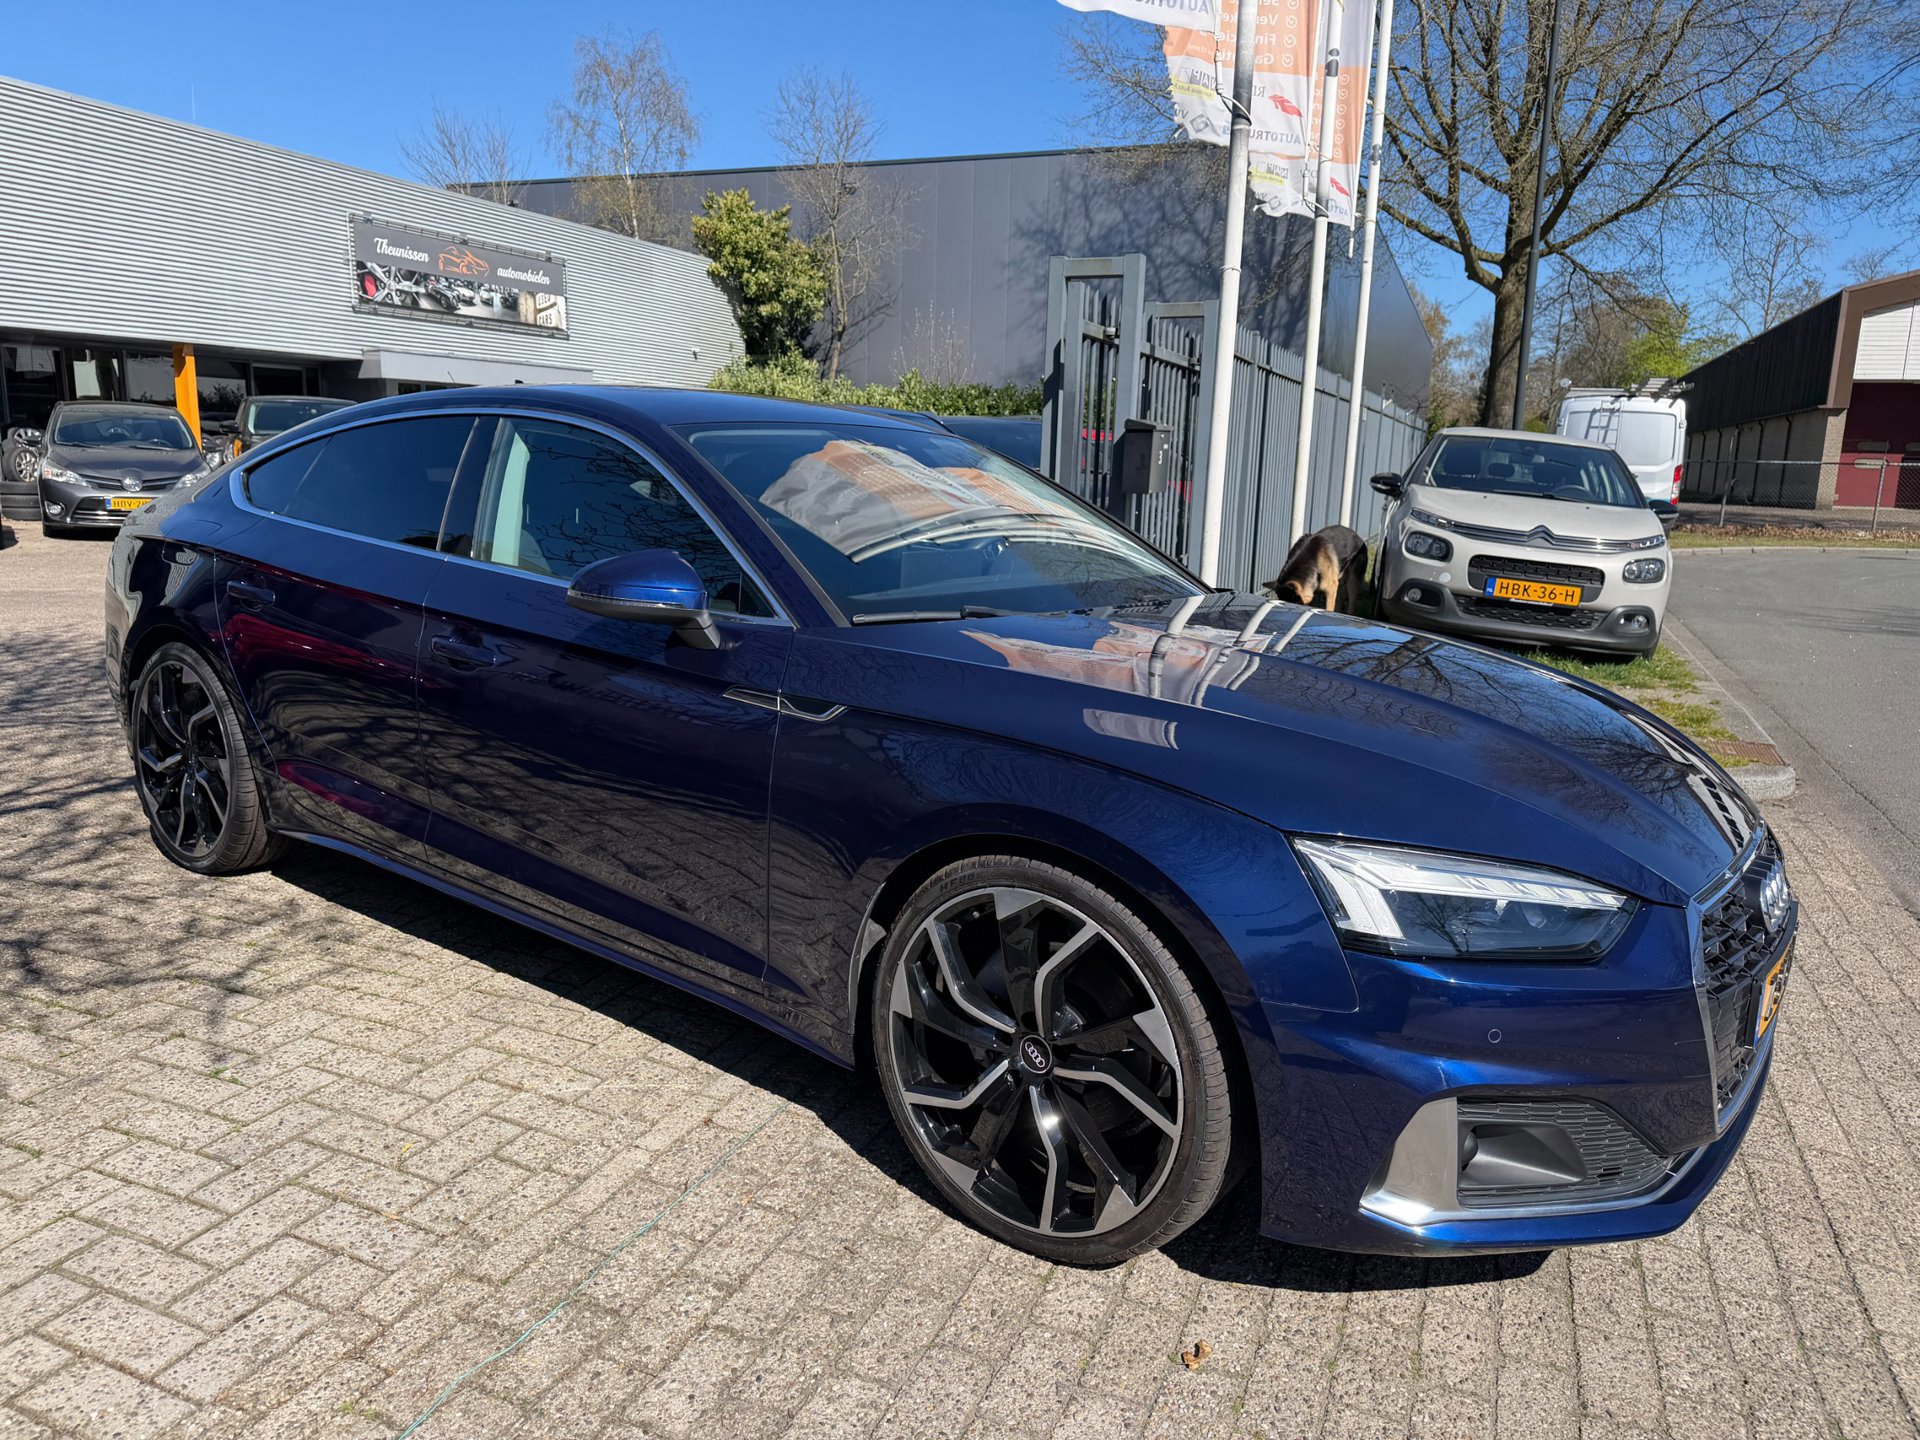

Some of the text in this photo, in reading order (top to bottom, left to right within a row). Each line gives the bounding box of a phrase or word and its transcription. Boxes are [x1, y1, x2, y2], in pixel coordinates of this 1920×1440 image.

[373, 237, 430, 263] Theunissen
[497, 266, 551, 286] automobielen
[1499, 582, 1575, 602] HBK-36-H
